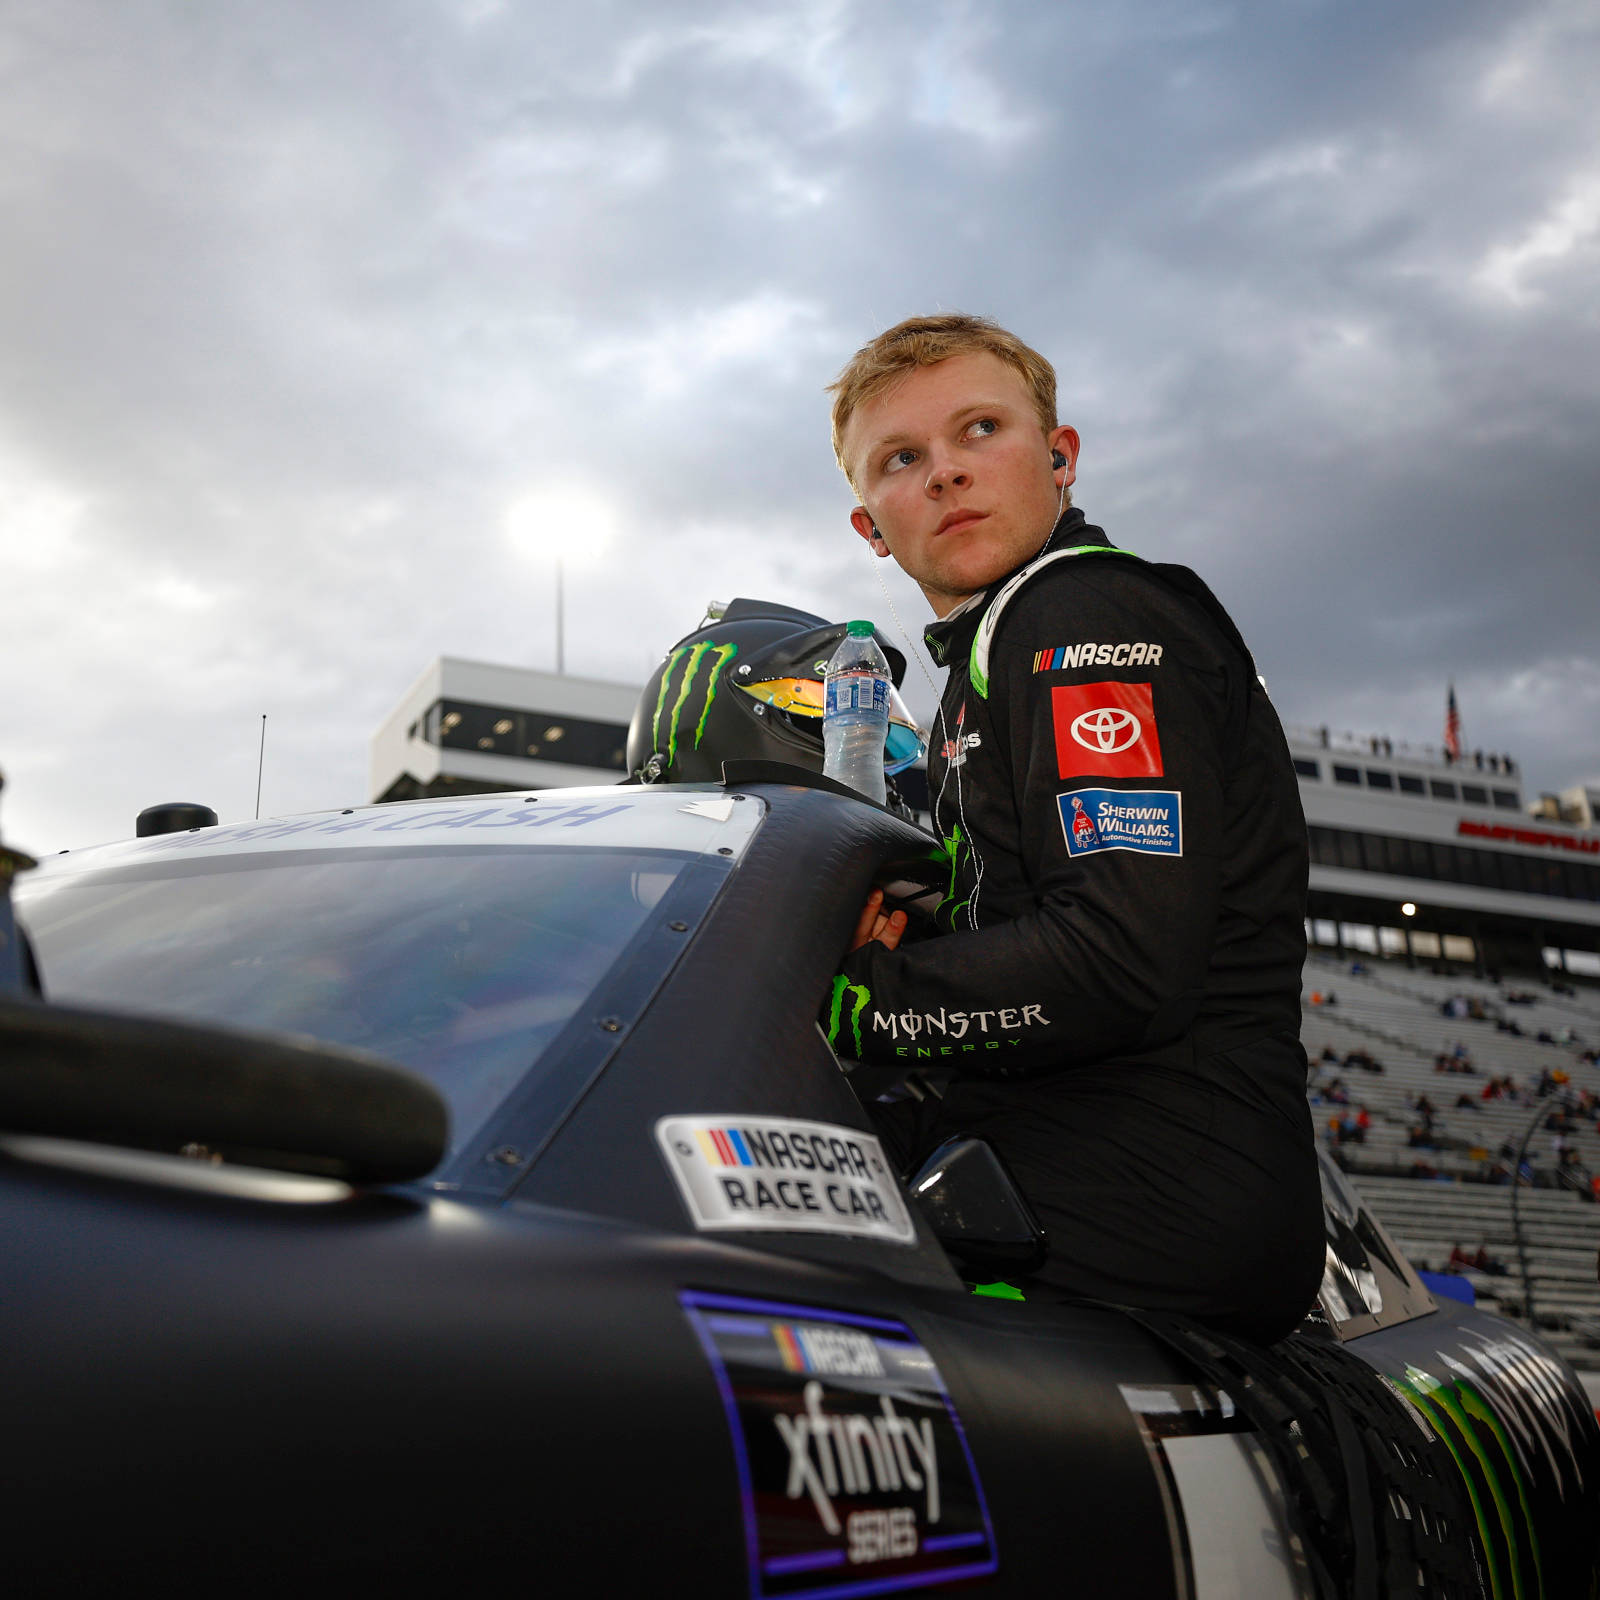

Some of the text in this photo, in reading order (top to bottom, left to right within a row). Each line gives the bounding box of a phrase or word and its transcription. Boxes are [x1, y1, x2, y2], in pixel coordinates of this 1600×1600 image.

[1062, 643, 1163, 670] NASCAR
[372, 804, 636, 832] CASH
[1097, 801, 1169, 821] SHERWIN
[1102, 834, 1173, 847] Automotive Finishes
[896, 1038, 1022, 1058] ENERGY
[742, 1128, 874, 1181] NASCAR
[720, 1176, 890, 1222] RACE CAR
[774, 1380, 941, 1536] xfinity
[847, 1507, 918, 1565] SERIES
